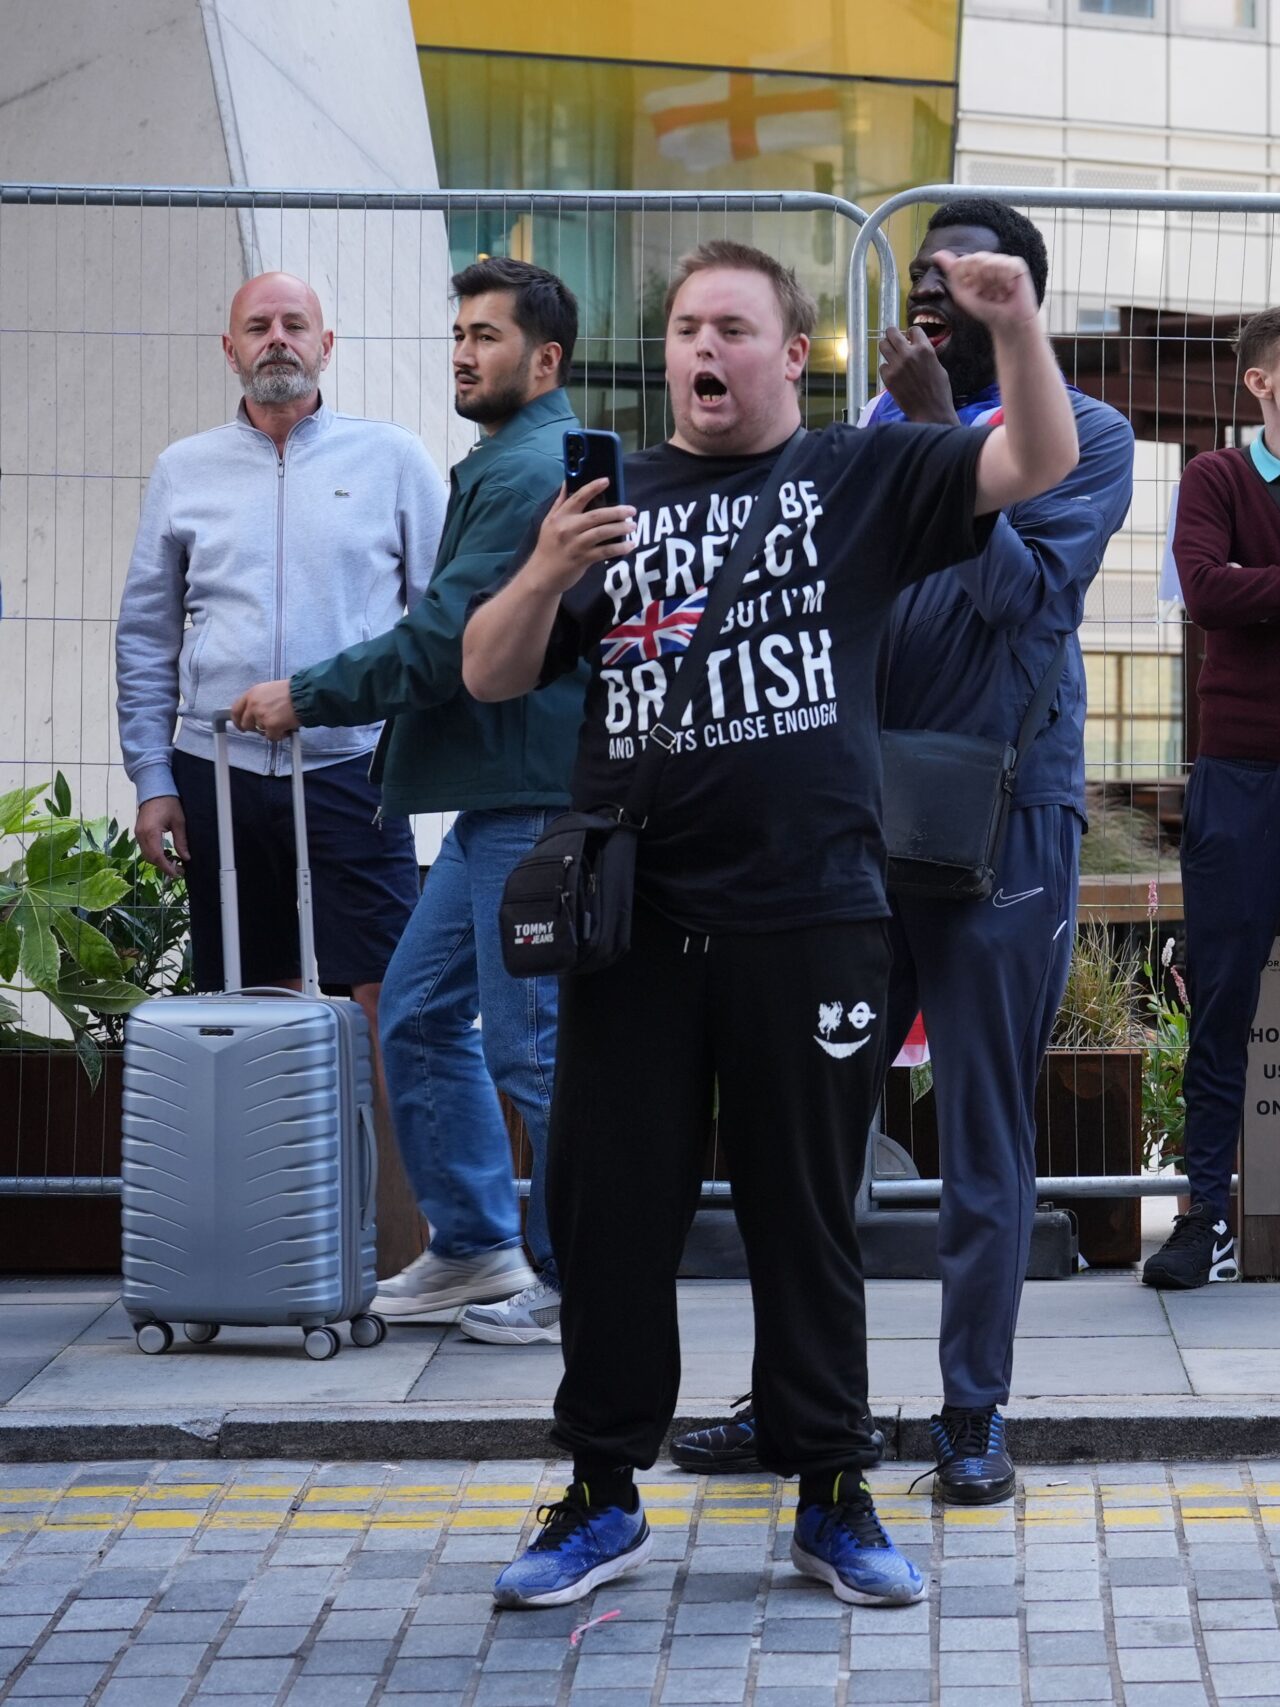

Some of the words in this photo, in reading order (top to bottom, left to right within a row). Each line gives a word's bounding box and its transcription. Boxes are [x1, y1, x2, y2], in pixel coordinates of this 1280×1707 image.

[625, 501, 697, 548] MAY
[706, 494, 759, 532] NO
[779, 480, 823, 519] BE
[604, 516, 818, 625] PERFCT
[782, 580, 826, 617] I'M
[600, 629, 836, 734] BRTISH
[608, 736, 635, 760] AND
[638, 728, 697, 754] TTS
[703, 715, 769, 747] CLOSE
[773, 702, 838, 735] ENOUGH
[514, 921, 554, 937] TOMMY
[531, 932, 554, 944] JEANS
